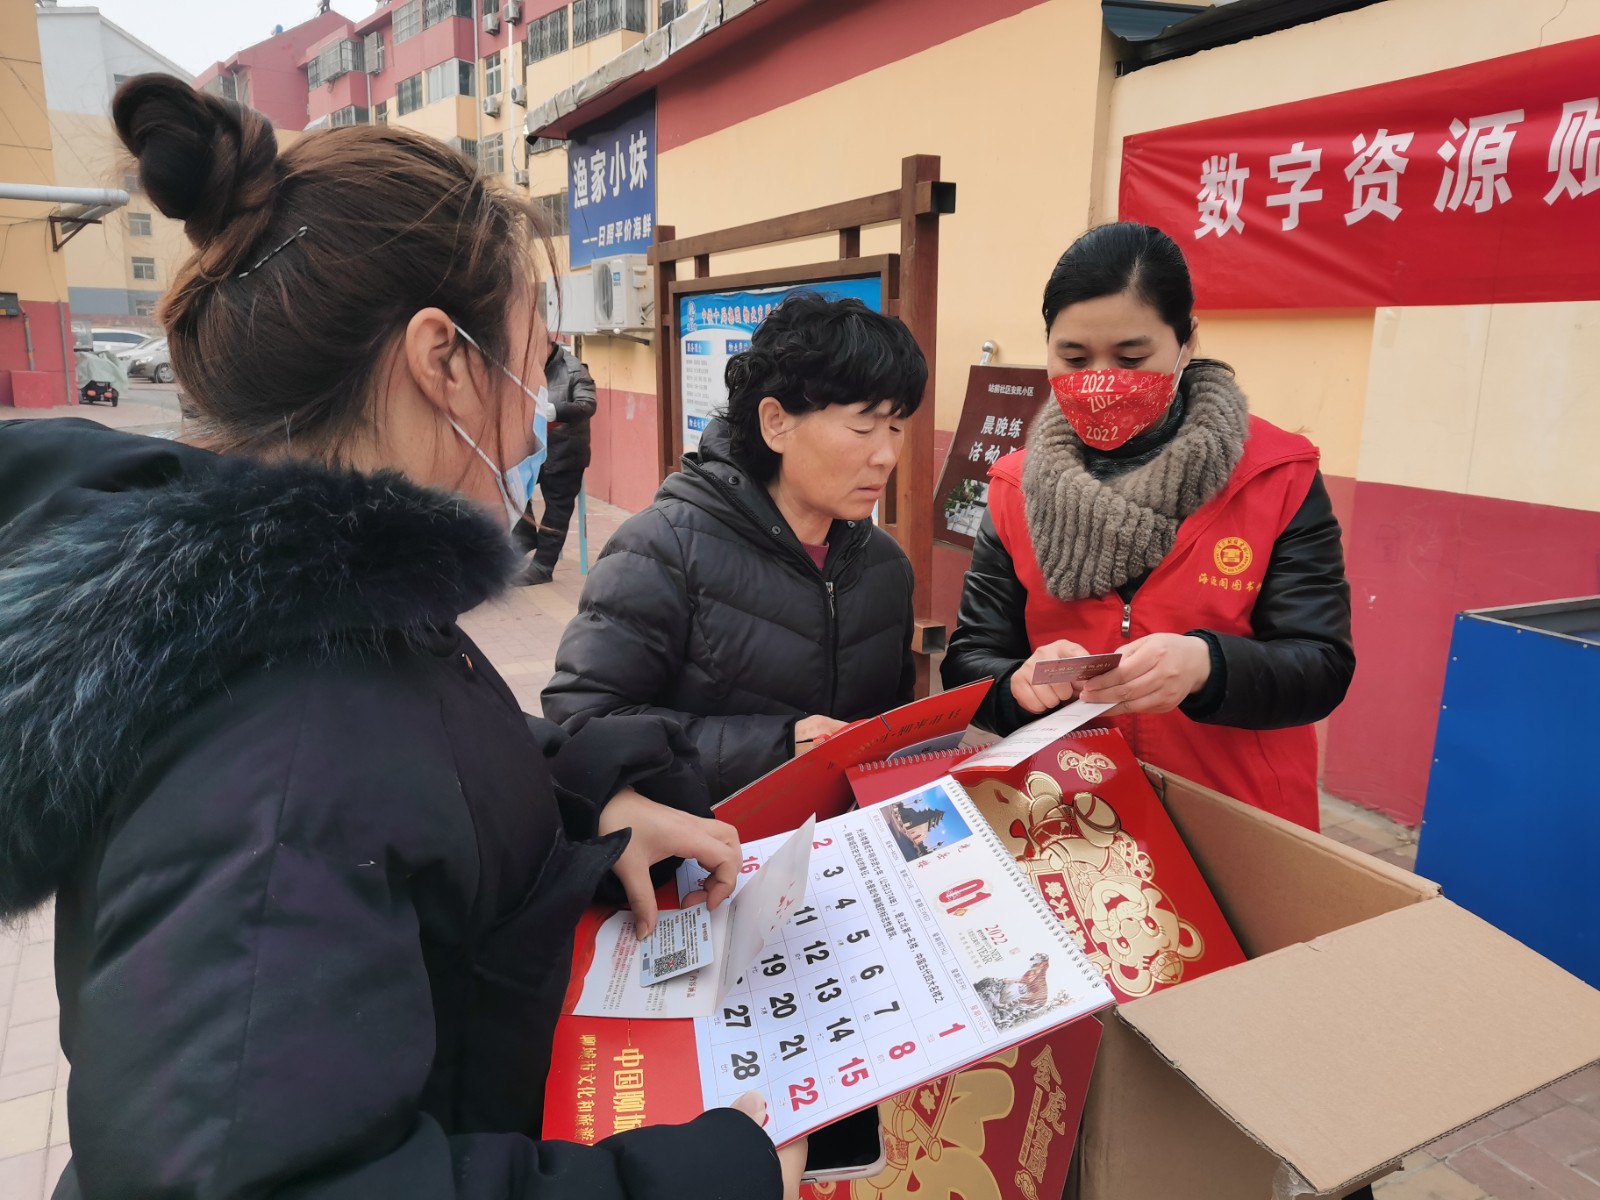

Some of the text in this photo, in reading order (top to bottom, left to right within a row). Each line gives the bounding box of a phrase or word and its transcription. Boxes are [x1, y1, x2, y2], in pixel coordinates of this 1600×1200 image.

[573, 129, 648, 209] 渔家小妹
[1080, 373, 1117, 394] 2022
[981, 415, 1024, 439] 晨晚练
[1086, 425, 1119, 442] 2022
[939, 879, 991, 915] 01
[812, 838, 915, 1059] 2 3 4 5 6 7 8
[985, 925, 1007, 945] 2022
[977, 946, 992, 964] YEAR
[990, 949, 1002, 961] NEW
[739, 856, 818, 1111] 16 19 20 21 22
[794, 906, 869, 1086] 11 12 13 14 15
[724, 1005, 760, 1080] 27 28
[939, 1023, 966, 1037] 1
[575, 1034, 596, 1146] 聊城市文化和旅游
